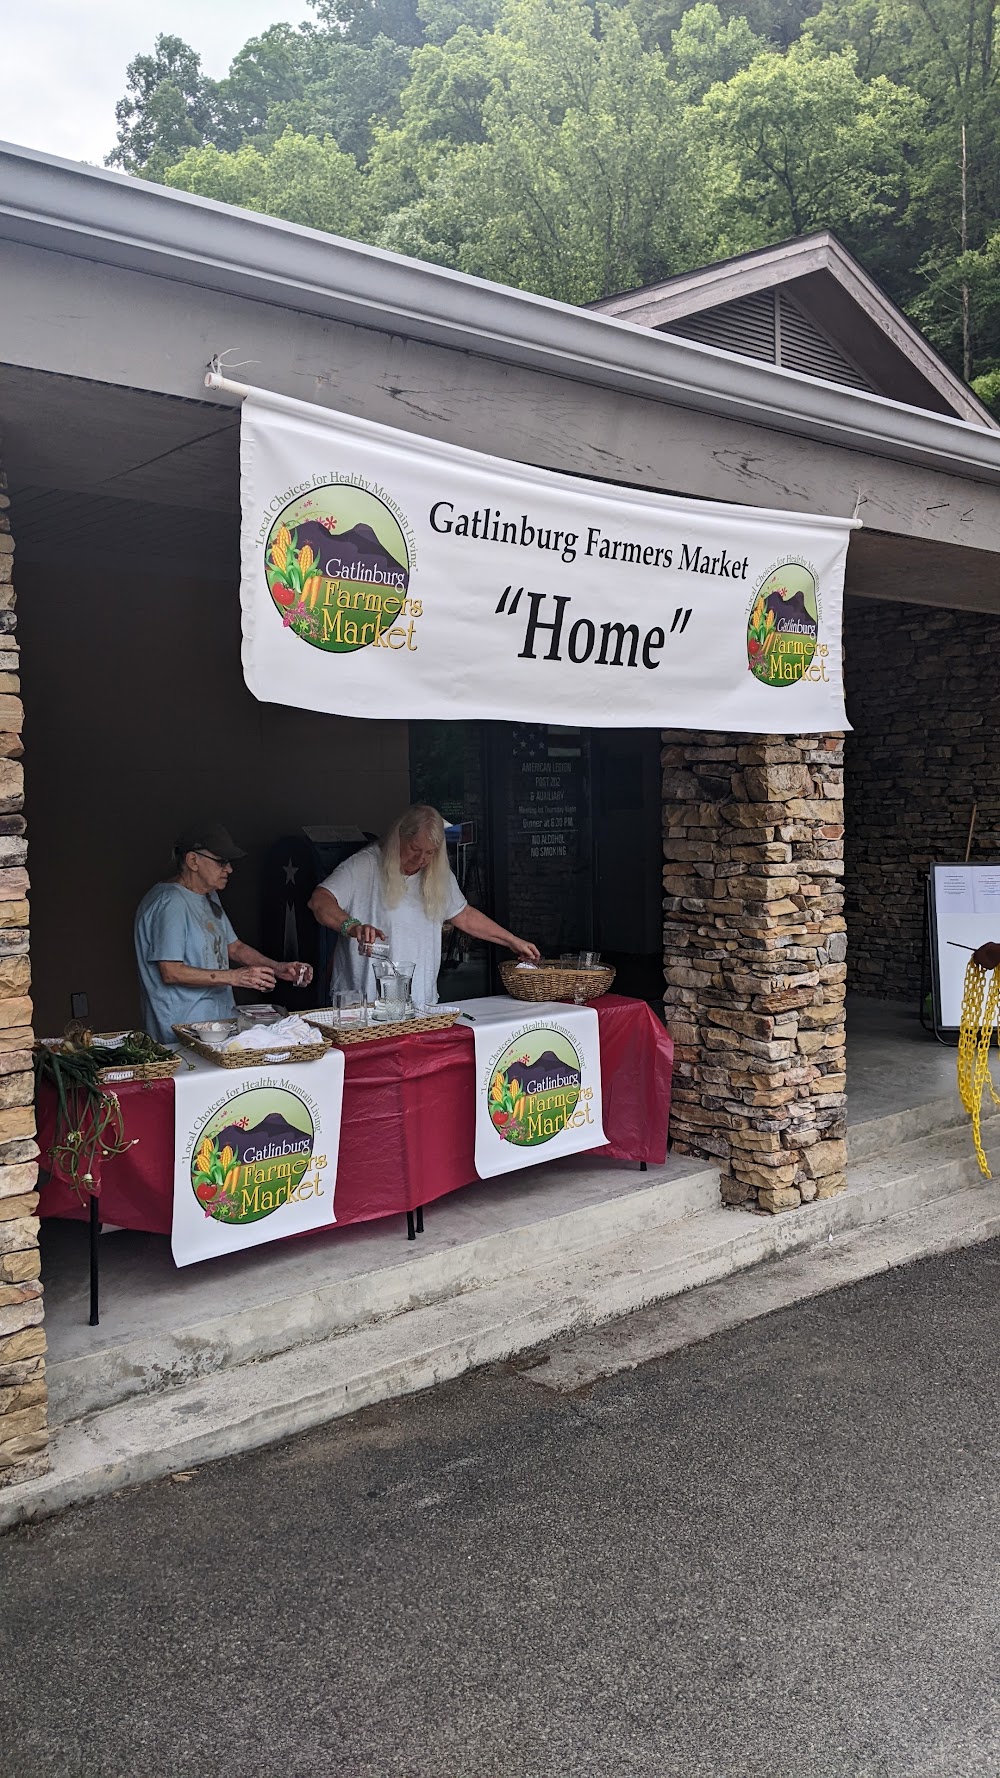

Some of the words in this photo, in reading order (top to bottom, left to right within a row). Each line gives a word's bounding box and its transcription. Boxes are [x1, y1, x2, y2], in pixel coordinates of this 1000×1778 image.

[269, 480, 311, 512] Choices
[312, 473, 328, 487] for
[329, 471, 372, 490] Healthy
[372, 482, 410, 531] Mountain
[428, 500, 579, 563] Gatlinburg
[584, 527, 673, 569] Farmers
[677, 543, 749, 580] Market
[325, 558, 405, 594] Gatlinburg
[755, 562, 777, 587] Choices
[776, 556, 786, 565] for
[786, 554, 807, 566] Healthy
[322, 580, 424, 618] Farmers
[320, 608, 419, 651] Market
[777, 617, 816, 640] Gatlinburg
[771, 633, 830, 657] Farmers
[769, 654, 830, 683] Market
[521, 762, 552, 773] AMERICAN
[552, 762, 572, 773] LEGION
[535, 777, 550, 787] POST
[536, 790, 565, 801] AUXILIARY
[522, 818, 543, 829] Dinner
[543, 818, 550, 828] at
[530, 847, 539, 857] NO
[539, 845, 567, 857] SMOKING
[531, 834, 540, 845] NO
[541, 833, 565, 845] ALCOHOL
[488, 1036, 512, 1065] Choices
[511, 1029, 522, 1041] for
[521, 1019, 550, 1033] Healthy
[550, 1020, 577, 1045] Mountain
[526, 1073, 580, 1095] Gatlinburg
[193, 1096, 226, 1130] Choices
[225, 1087, 240, 1100] for
[241, 1077, 278, 1092] Healthy
[279, 1078, 313, 1105] Mountain
[527, 1086, 594, 1116] Farmers
[526, 1102, 595, 1142] Market
[243, 1137, 312, 1165] Gatlinburg
[242, 1152, 329, 1188] Farmers
[238, 1171, 325, 1219] Market
